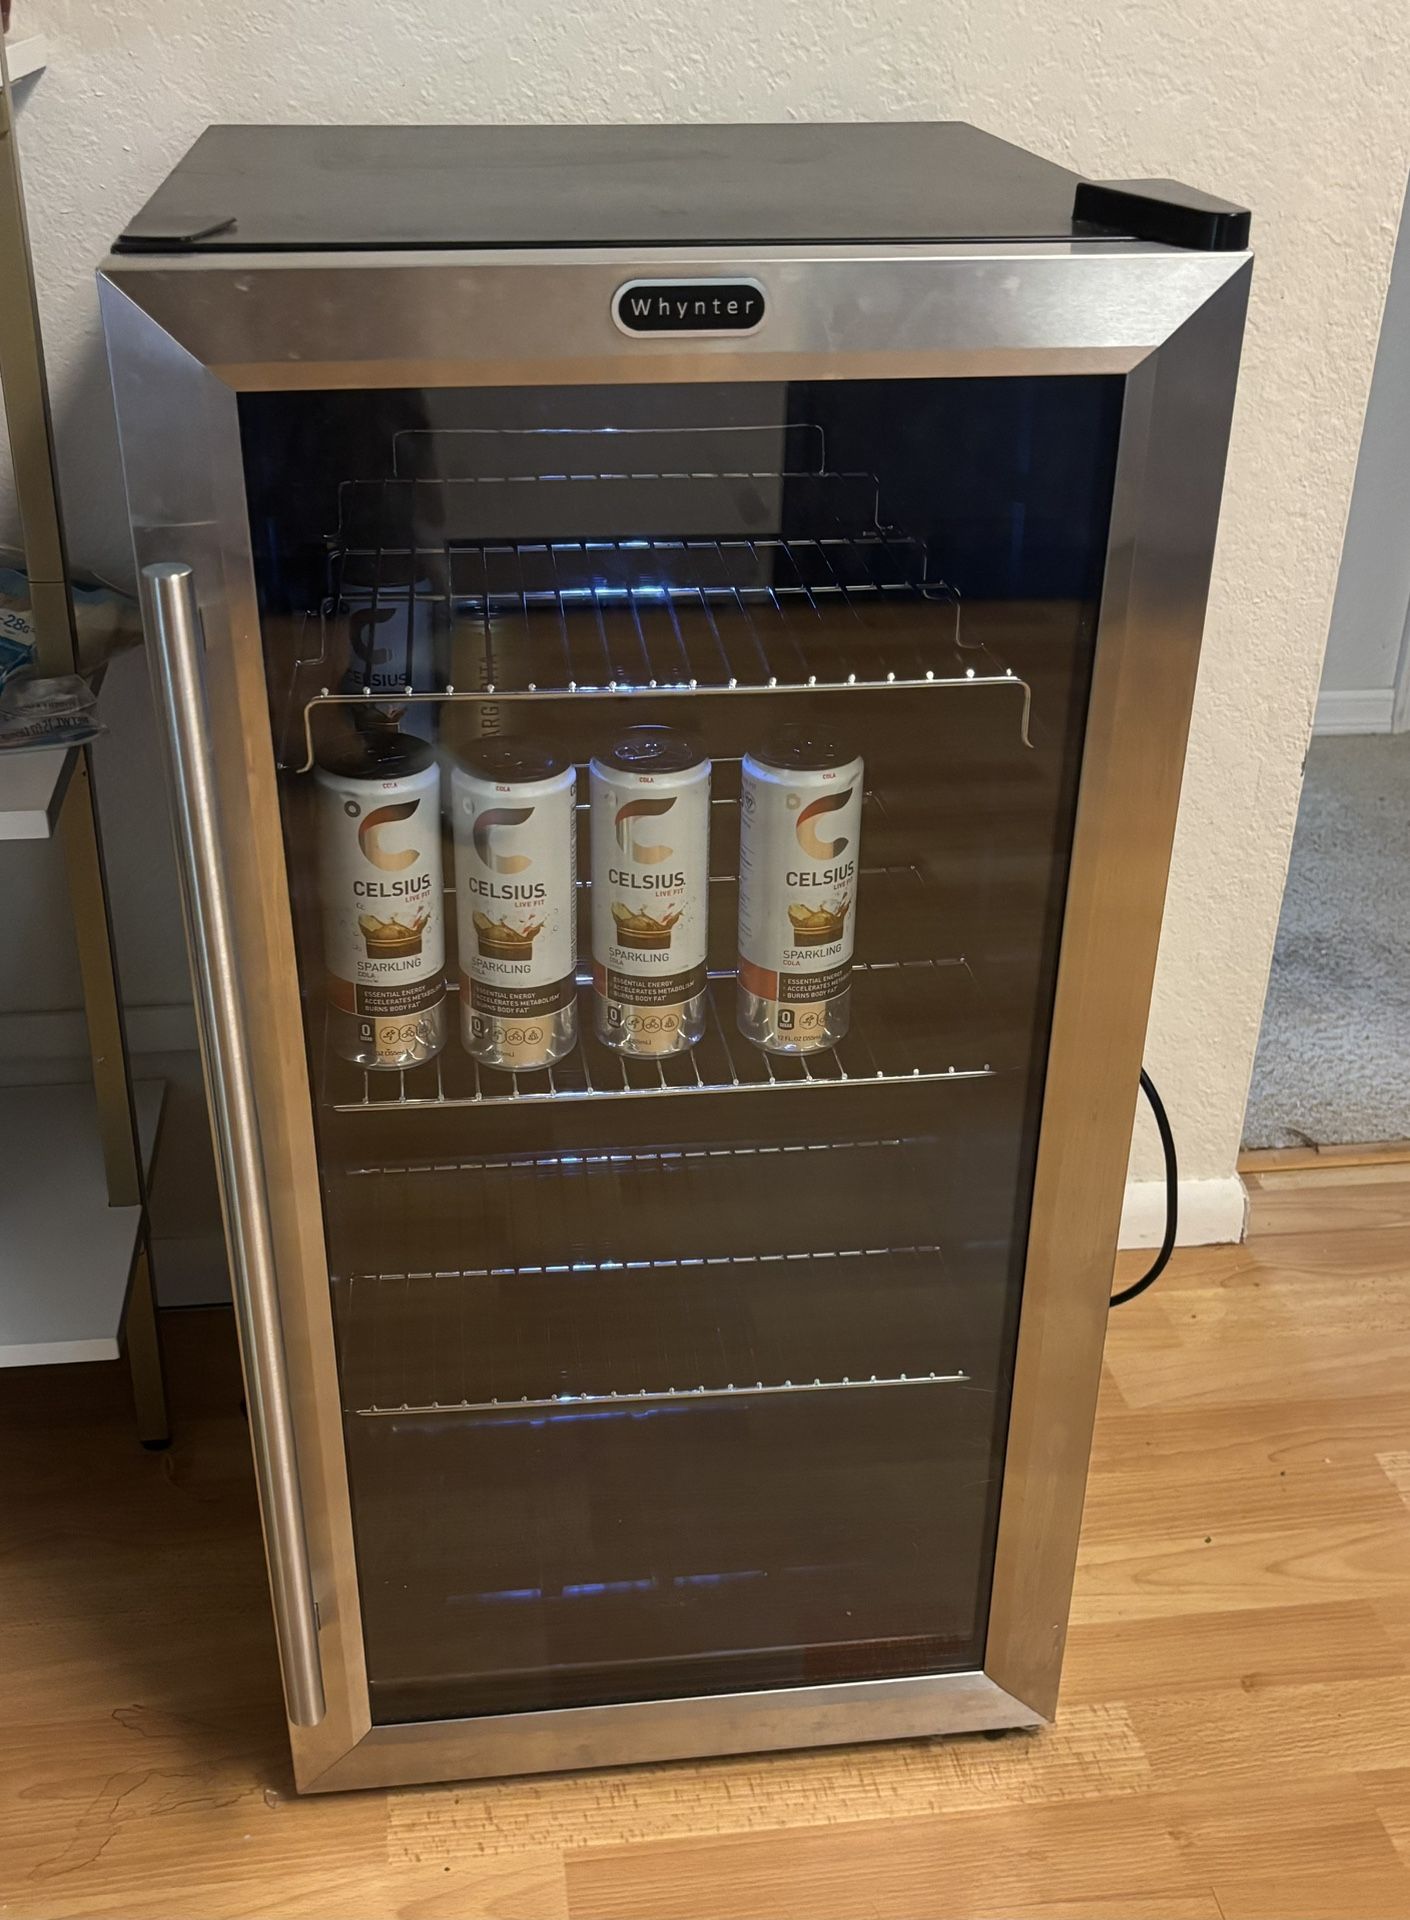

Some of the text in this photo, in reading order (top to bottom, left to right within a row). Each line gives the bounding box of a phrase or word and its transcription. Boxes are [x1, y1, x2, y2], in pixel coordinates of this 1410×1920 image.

[630, 296, 754, 319] Whynter
[655, 887, 684, 897] LIVE FIT
[608, 946, 670, 963] SPARKLING
[783, 943, 842, 960] SPARKLING
[356, 957, 421, 972] SPARKLING
[787, 977, 822, 985] ESSENTIAL
[787, 991, 810, 999] BURNS
